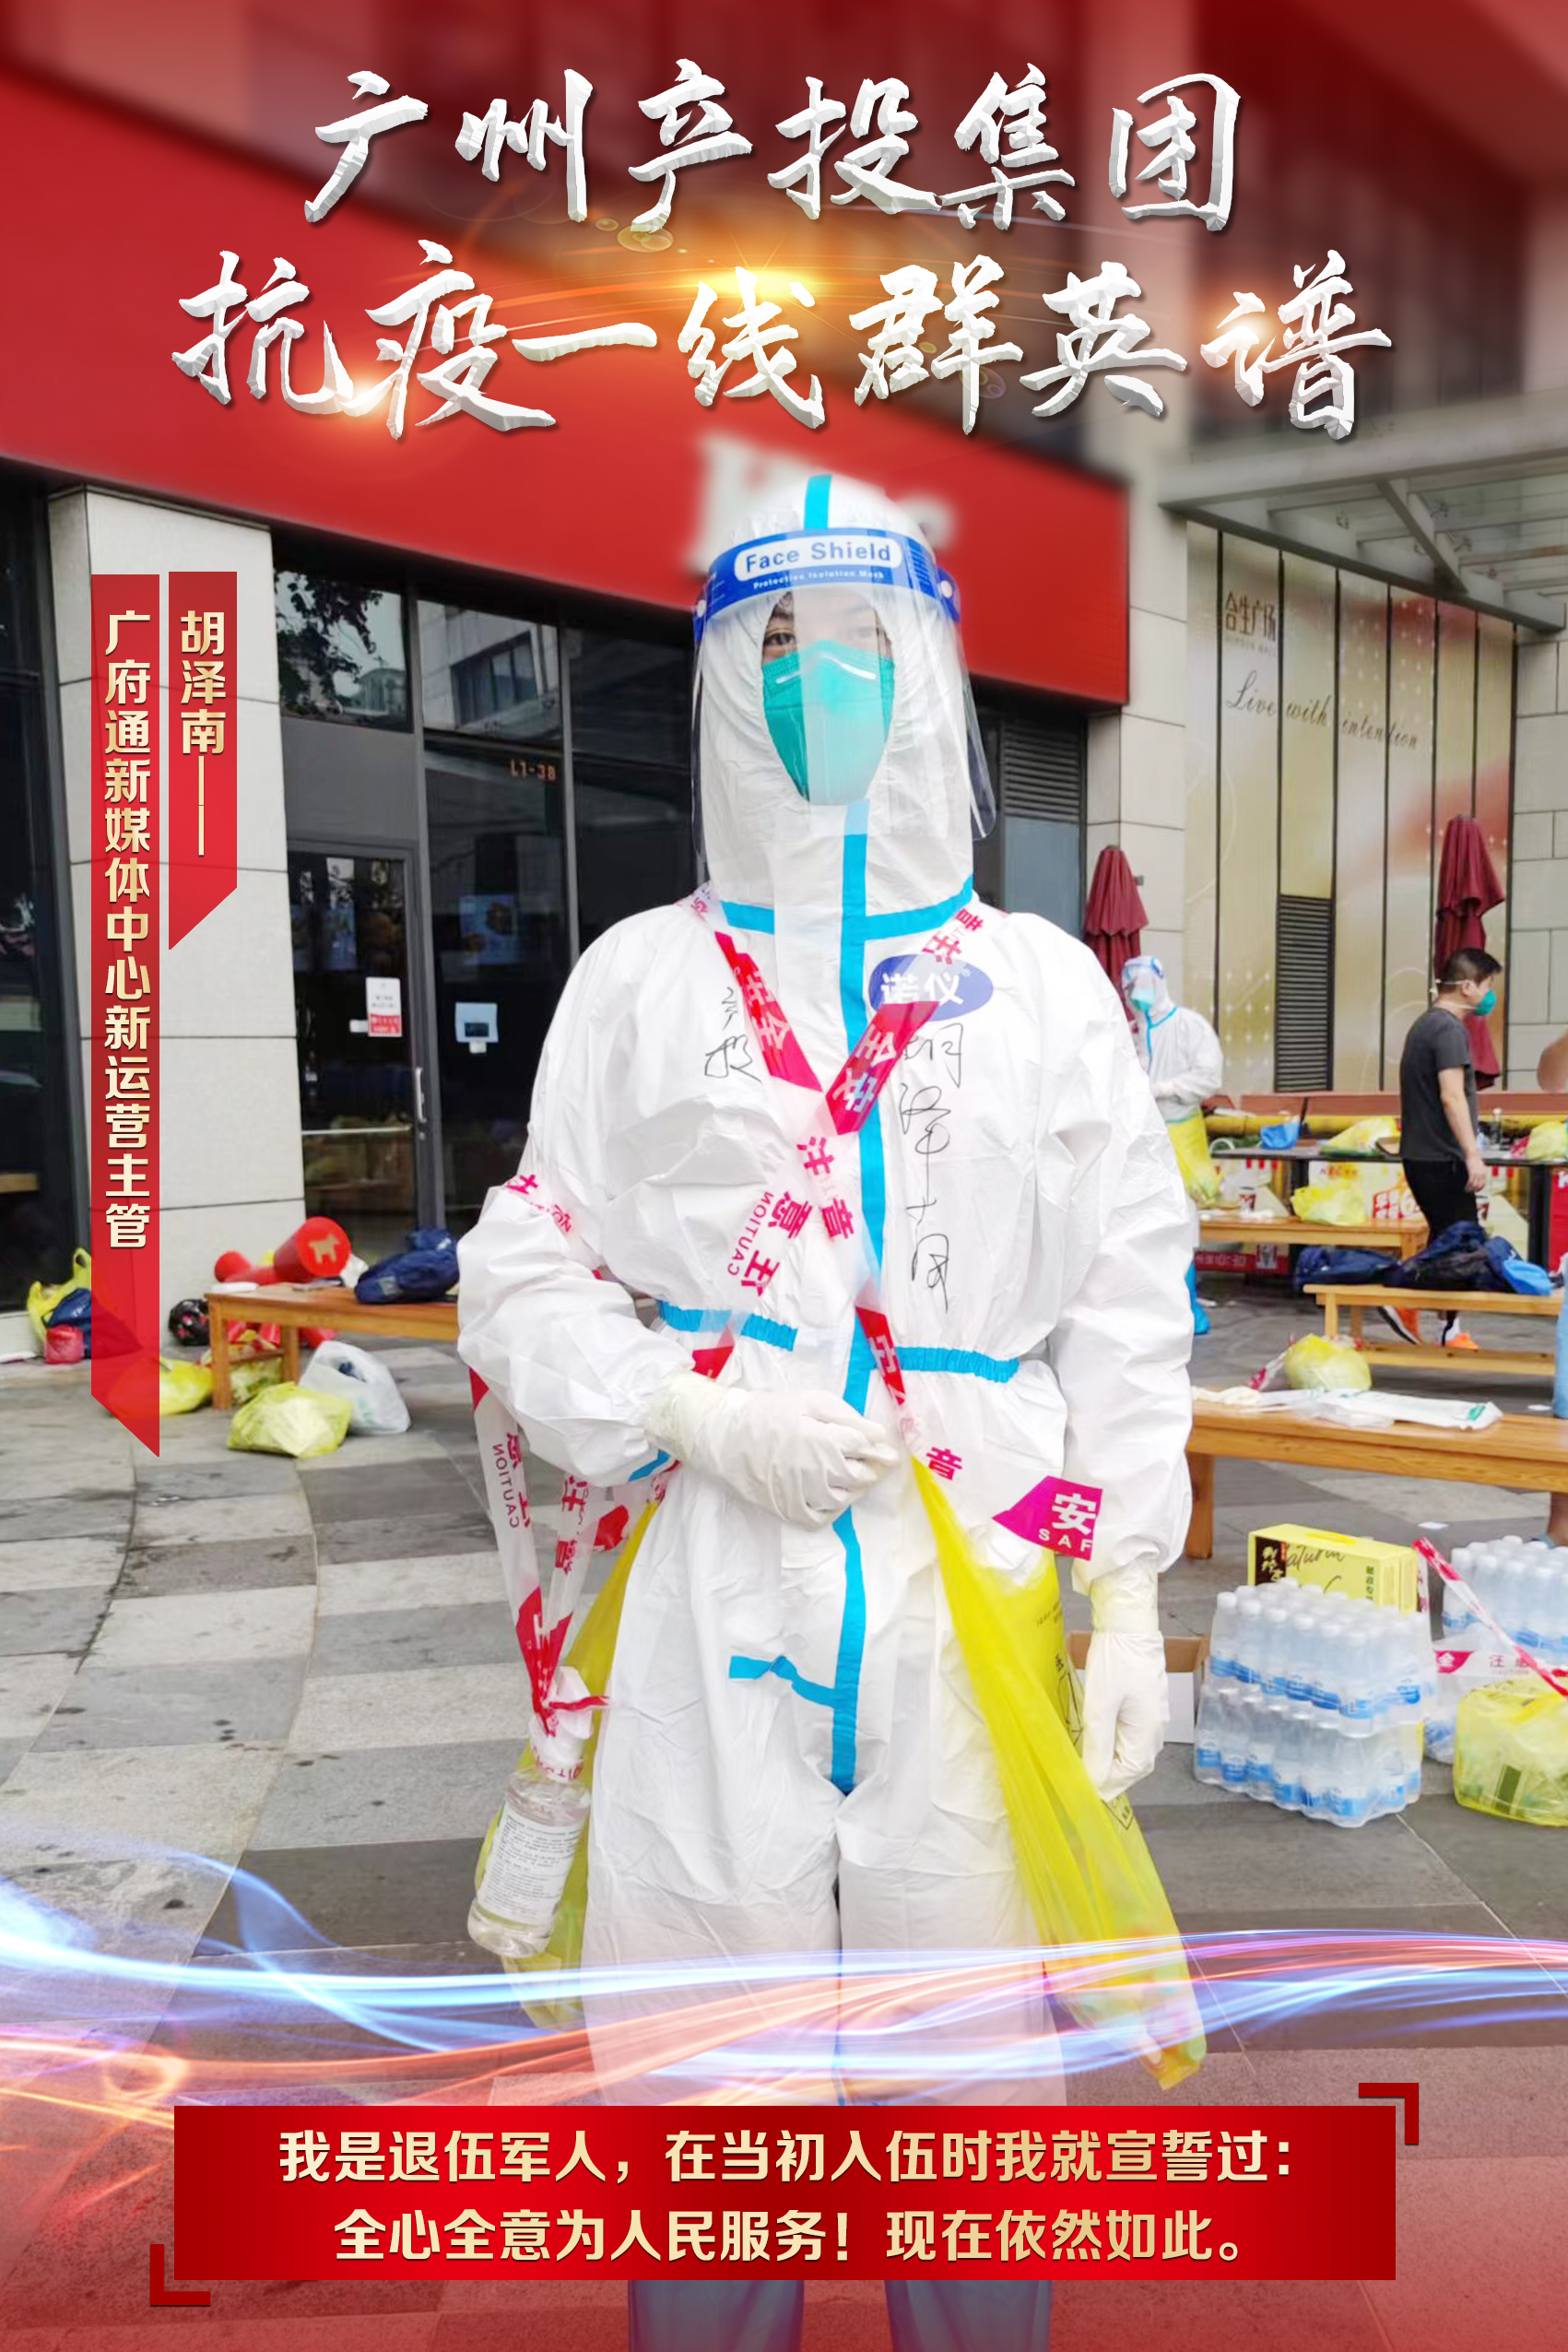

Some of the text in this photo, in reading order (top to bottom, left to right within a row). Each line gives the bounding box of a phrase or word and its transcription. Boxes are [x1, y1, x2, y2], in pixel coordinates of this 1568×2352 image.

[745, 541, 891, 573] Face Shield
[752, 573, 806, 590] Protective
[1226, 669, 1418, 750] Live with intention
[1051, 1493, 1097, 1535] 安
